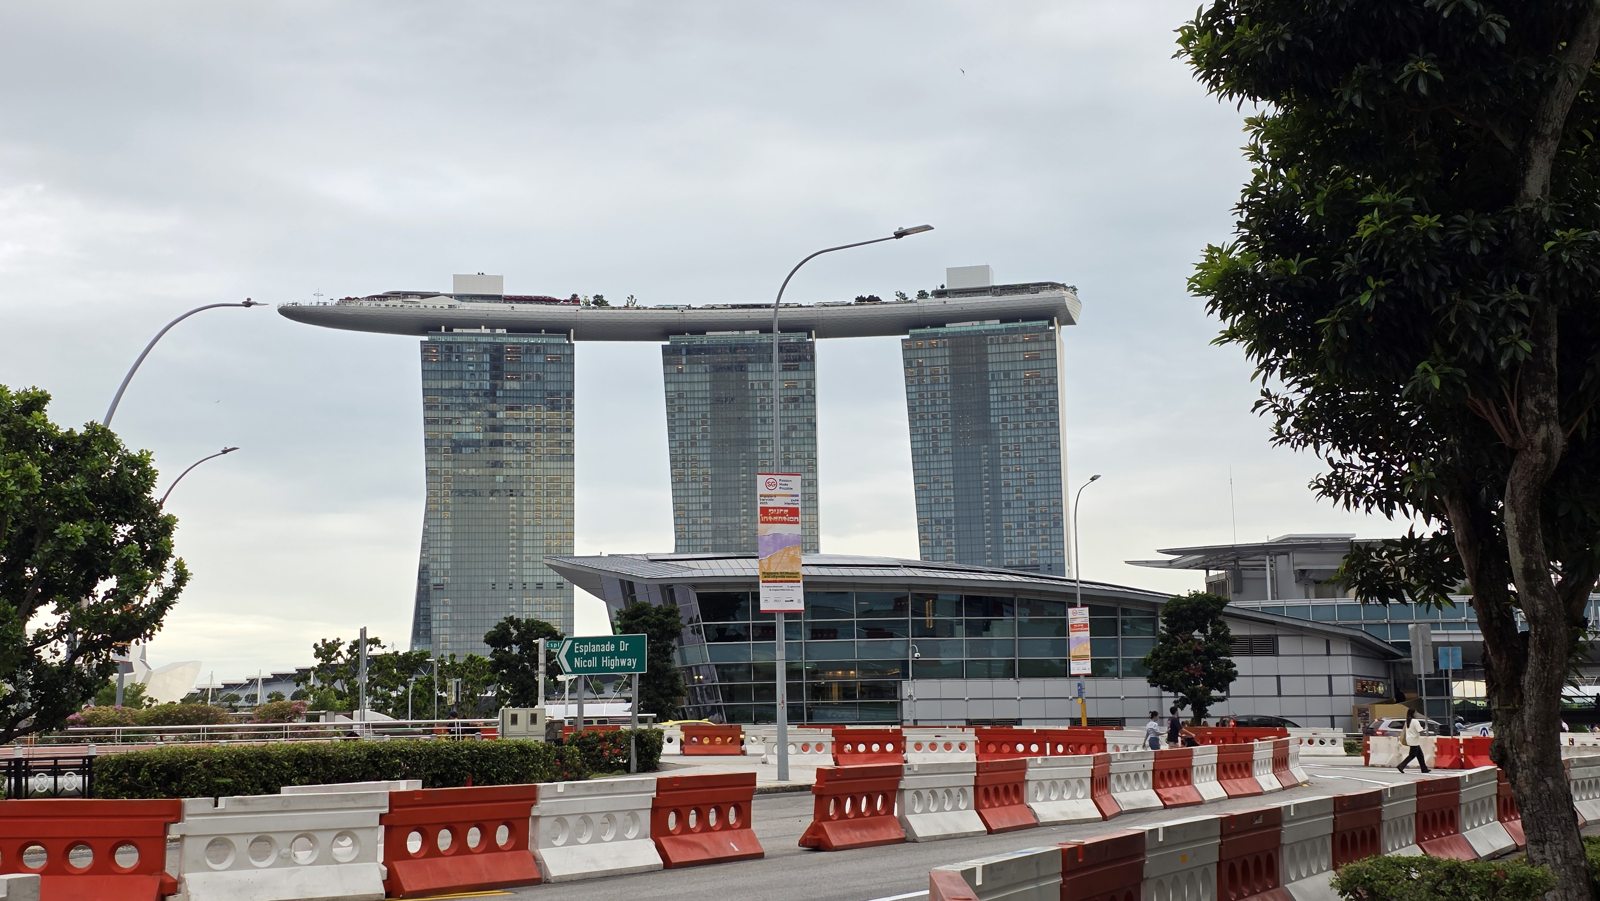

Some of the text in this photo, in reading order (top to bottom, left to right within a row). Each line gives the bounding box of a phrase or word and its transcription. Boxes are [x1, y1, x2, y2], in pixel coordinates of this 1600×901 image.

[574, 640, 629, 655] Esplanade Dr
[574, 656, 637, 669] Nicoll Highway
